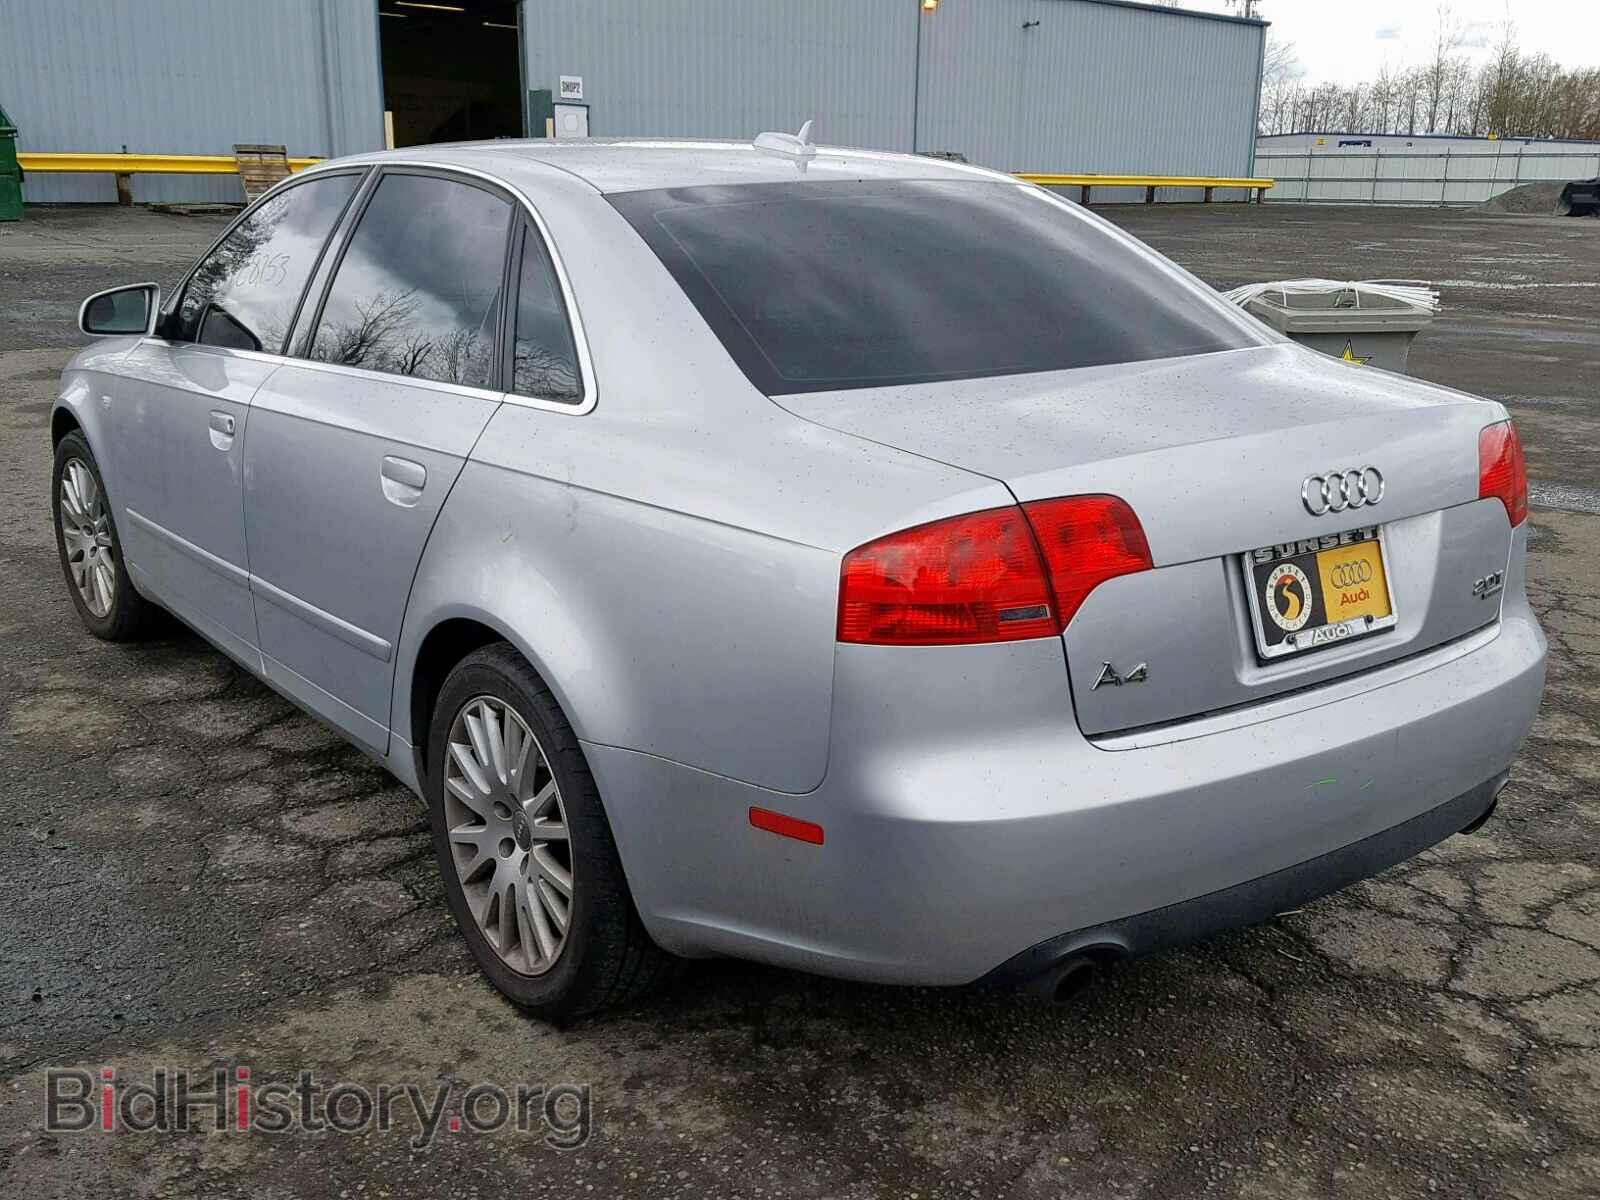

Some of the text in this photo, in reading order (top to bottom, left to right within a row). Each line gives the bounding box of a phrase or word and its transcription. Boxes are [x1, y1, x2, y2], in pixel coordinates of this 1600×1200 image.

[1254, 526, 1379, 563] SUNSET
[1340, 588, 1370, 606] Audi
[1090, 660, 1147, 691] A4
